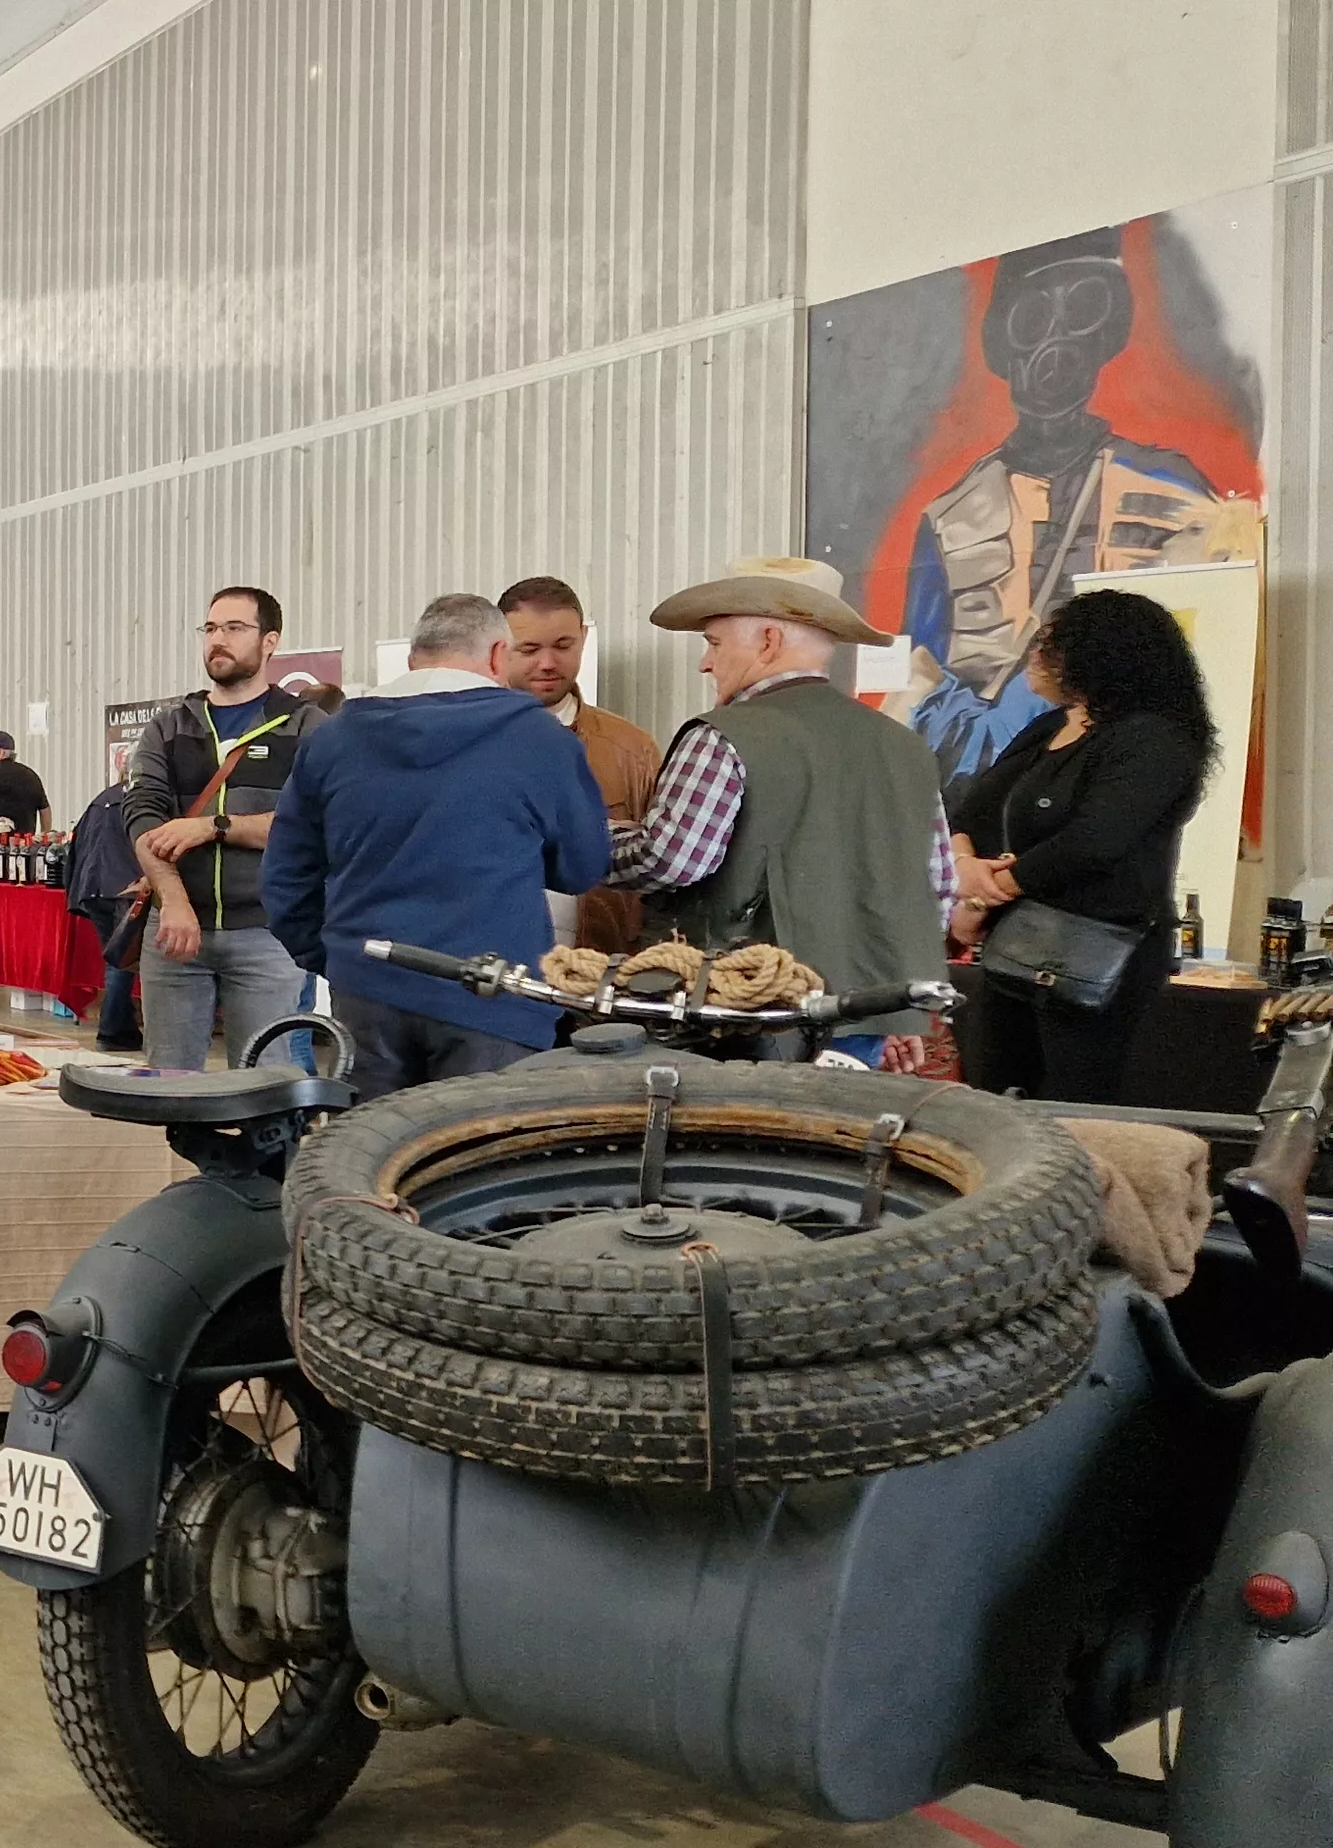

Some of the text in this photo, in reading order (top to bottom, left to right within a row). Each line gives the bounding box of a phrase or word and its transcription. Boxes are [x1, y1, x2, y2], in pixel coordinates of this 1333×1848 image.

[109, 711, 119, 727] LA
[119, 710, 137, 726] CASA
[7, 1458, 62, 1508] WH
